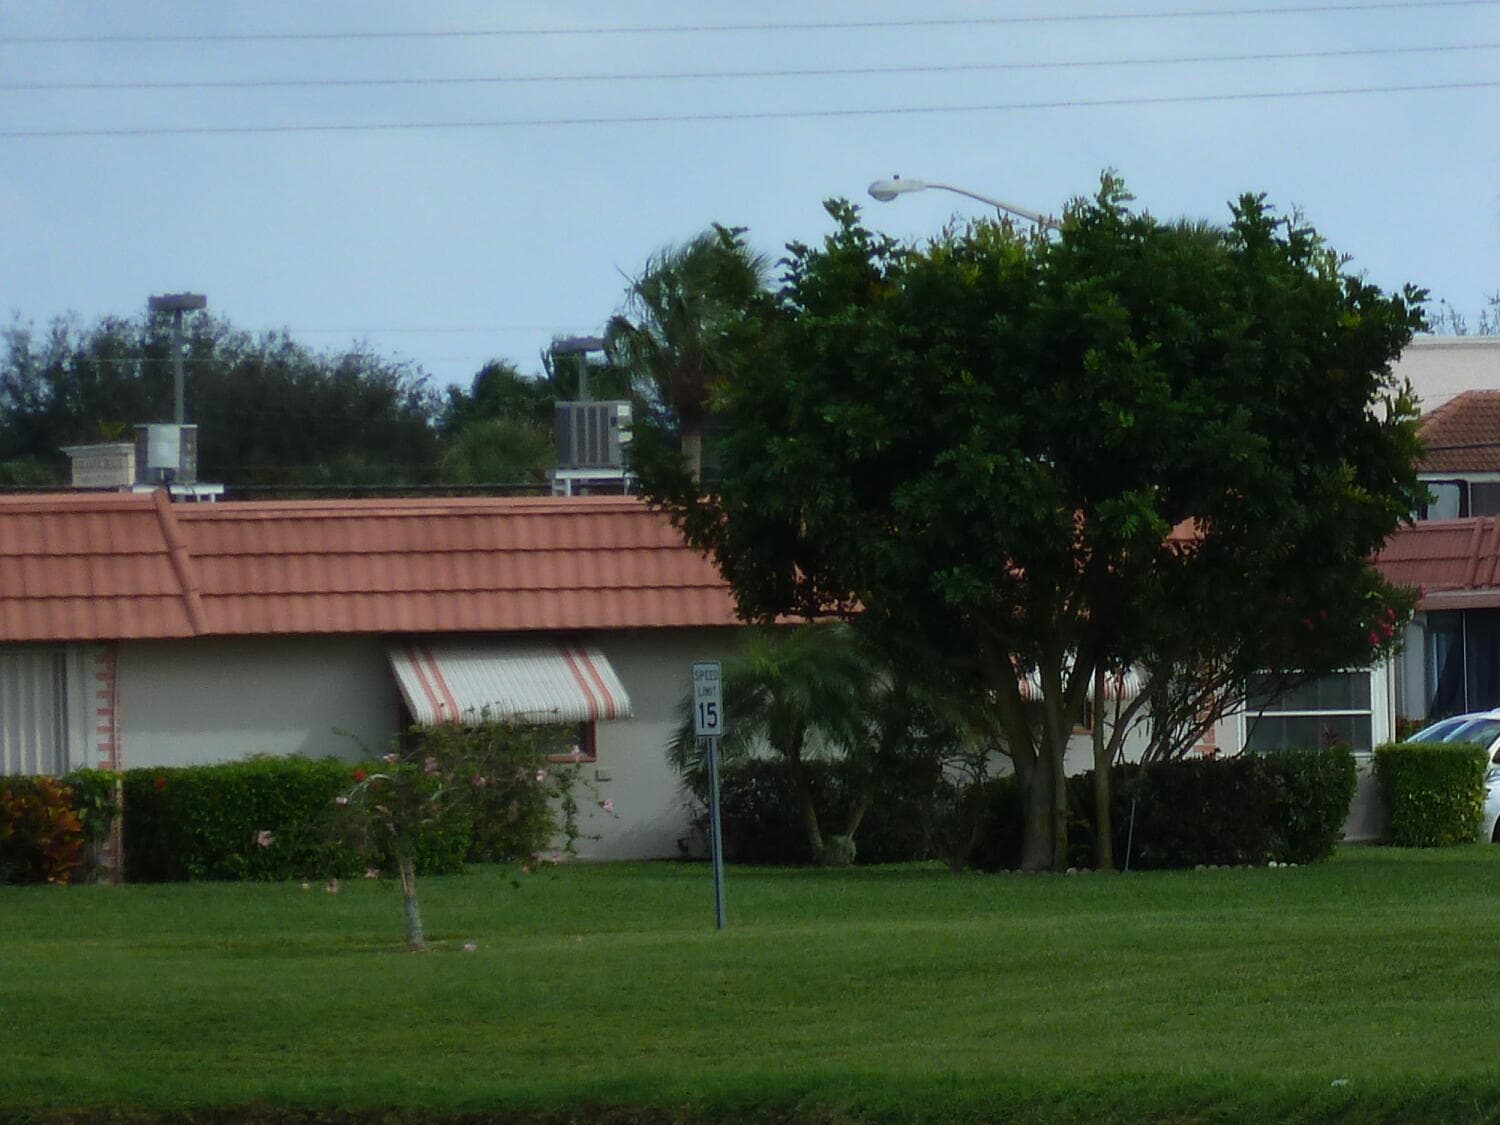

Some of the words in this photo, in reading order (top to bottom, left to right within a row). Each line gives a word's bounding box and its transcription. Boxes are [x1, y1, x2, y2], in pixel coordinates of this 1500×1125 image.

[694, 669, 718, 681] SPEED
[698, 686, 716, 697] LIMIT
[699, 702, 718, 729] 15
